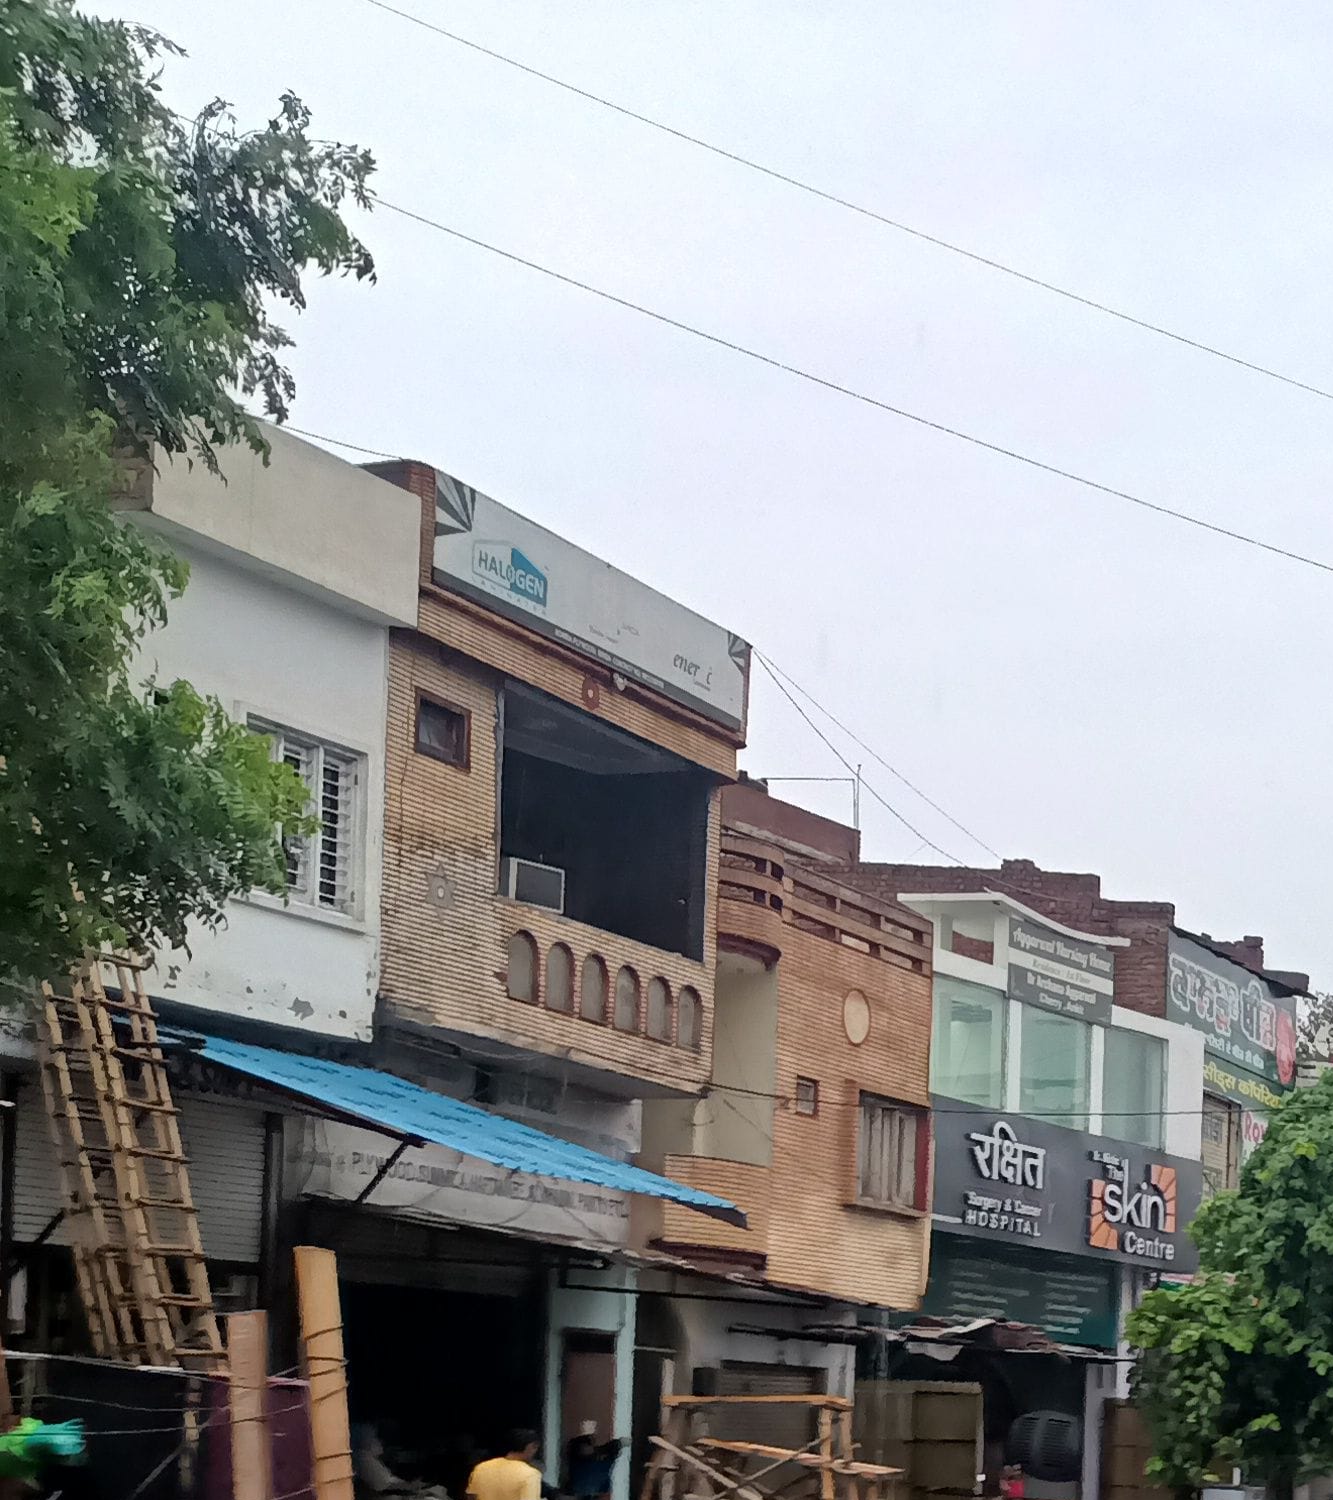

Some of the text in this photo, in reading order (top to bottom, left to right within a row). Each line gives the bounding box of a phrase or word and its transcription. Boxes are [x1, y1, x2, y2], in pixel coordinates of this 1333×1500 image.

[478, 550, 544, 598] HALOGEN
[970, 1121, 1047, 1189] रक्षित
[965, 1209, 1042, 1237] HOSPITAL
[1124, 1231, 1175, 1260] Centre
